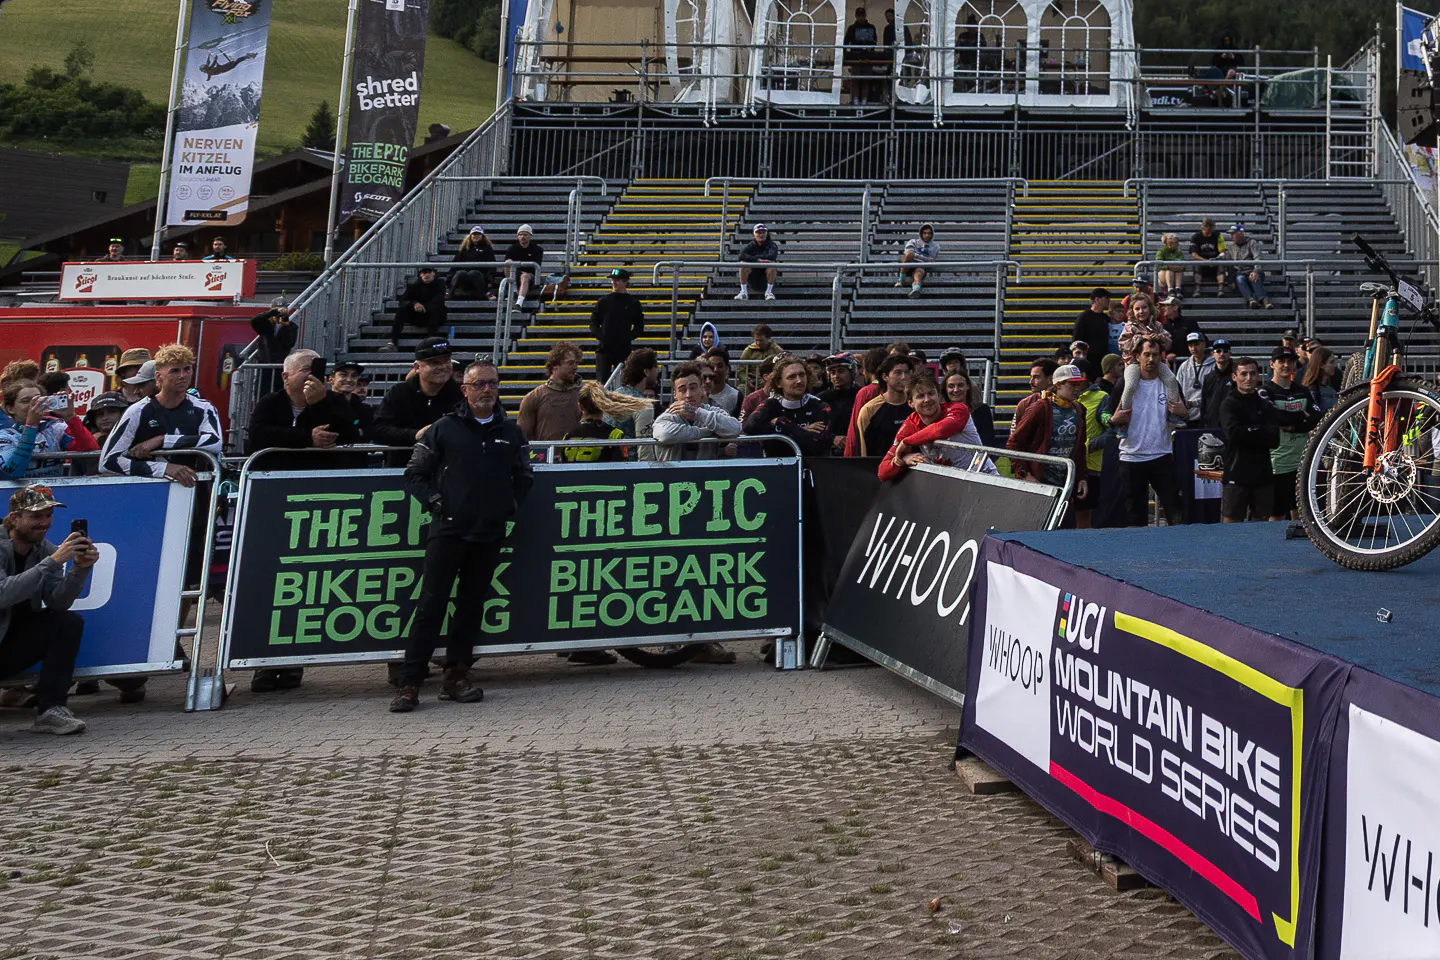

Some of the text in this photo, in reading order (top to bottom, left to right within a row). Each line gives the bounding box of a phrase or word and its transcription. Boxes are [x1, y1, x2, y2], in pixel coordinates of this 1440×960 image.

[356, 71, 418, 96] shred
[358, 93, 418, 111] better
[181, 151, 231, 164] KITZEL
[183, 137, 244, 150] NERVEN
[352, 142, 408, 163] THE EPIC
[178, 165, 242, 175] IM ANFLUG
[348, 173, 403, 188] LEOGANG
[349, 163, 404, 178] BIKEPARK
[204, 272, 228, 288] Stiegl
[555, 477, 768, 539] THE EPIC
[284, 508, 363, 550] THE
[549, 551, 767, 593] BIKEPARK
[857, 512, 979, 626] WHOO
[547, 584, 768, 630] LEOGANG
[1066, 593, 1107, 654] UCI
[988, 623, 1044, 696] WHOOP
[1055, 647, 1281, 809] MOUNTAIN BIKE
[1056, 695, 1281, 873] WORLD SERIES
